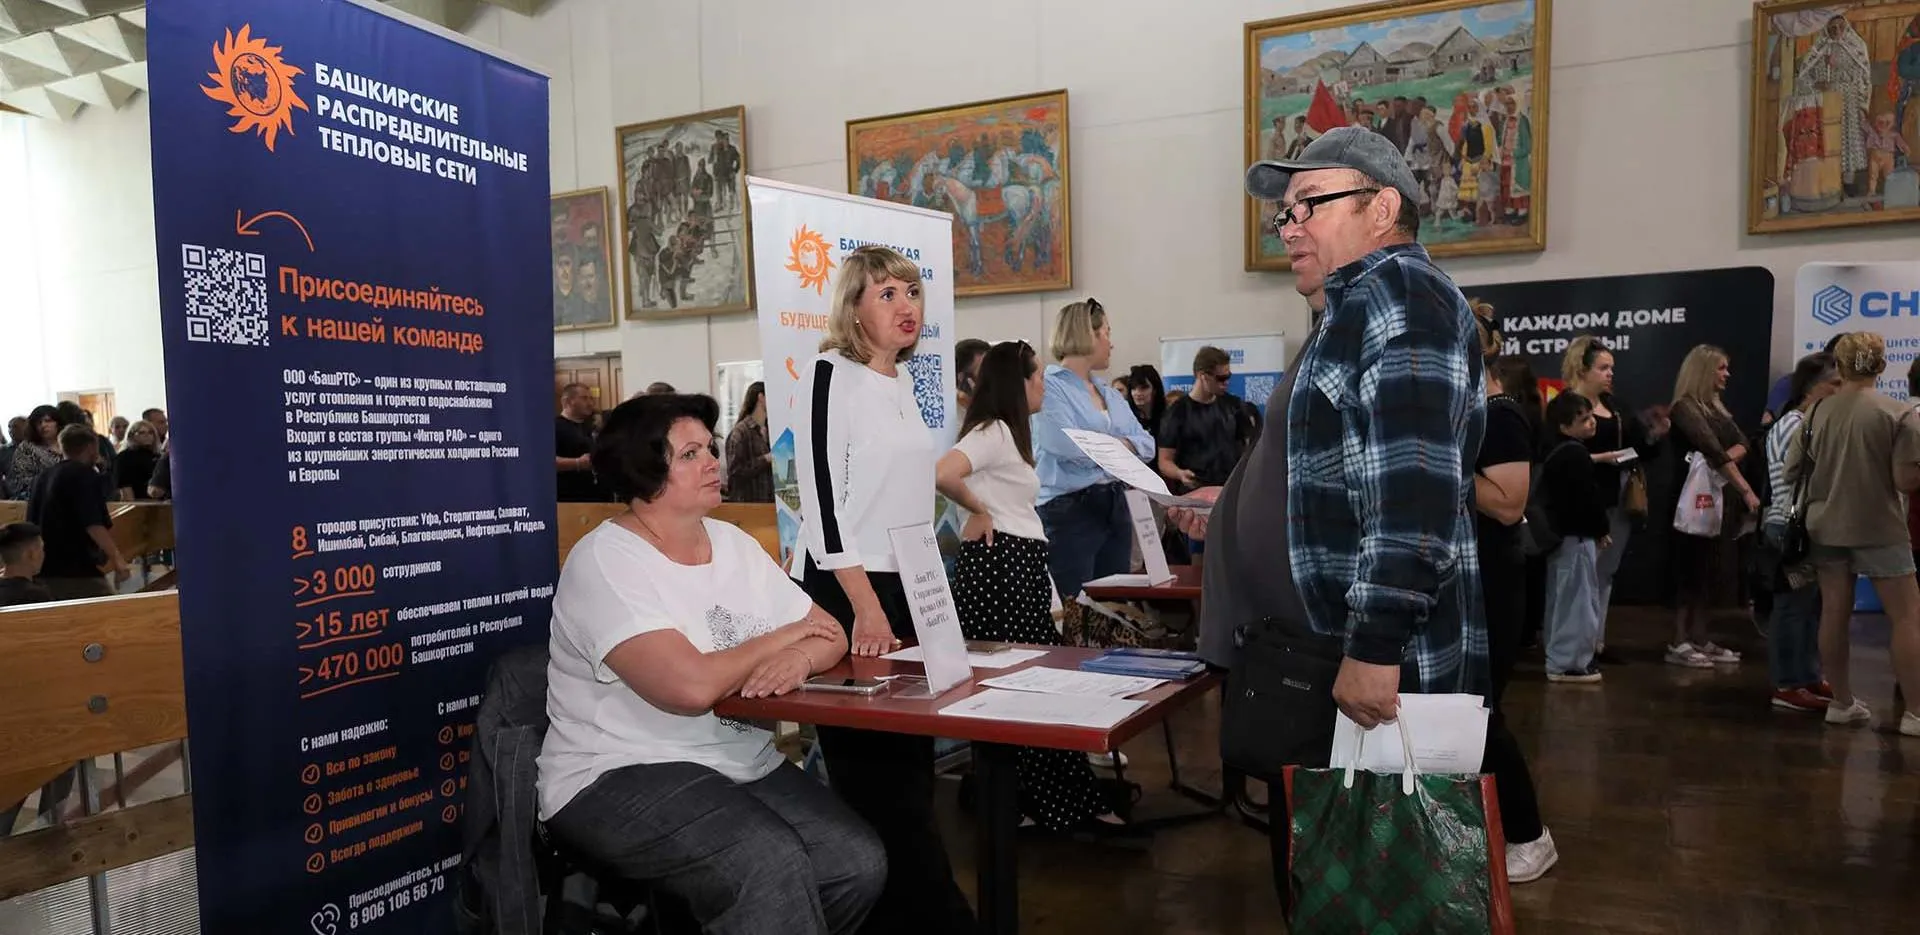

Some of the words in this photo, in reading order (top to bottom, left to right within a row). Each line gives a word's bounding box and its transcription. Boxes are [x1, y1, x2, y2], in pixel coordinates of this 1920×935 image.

[316, 62, 459, 125] БАШКИРСКИЕ
[317, 95, 528, 172] РАСПРЕДЕЛИТЕЛЬНЫЕ
[318, 127, 431, 173] ТЕПЛОВЫЕ
[436, 156, 477, 185] СЕТИ
[279, 266, 484, 316] Присоединяйтесь
[780, 311, 828, 330] БУДУЩЕ
[1503, 311, 1609, 332] КАЖДОМ
[1615, 307, 1686, 329] ДОМЕ
[282, 315, 298, 336] к
[307, 316, 385, 344] нашей
[393, 326, 483, 353] команде
[1526, 335, 1630, 355] СТРЫ!
[284, 369, 305, 384] ООО
[308, 371, 361, 387] «БашРТС»
[375, 376, 398, 390] один
[400, 378, 411, 389] из
[414, 378, 453, 391] крупных
[455, 380, 507, 393] поставщиков
[285, 391, 316, 406] услуг
[319, 392, 373, 405] отопления
[376, 394, 383, 406] и
[385, 395, 426, 408] горячего
[286, 411, 293, 423] в
[296, 409, 359, 426] Республике
[362, 411, 430, 426] Башкортостан
[286, 429, 326, 445] Входит
[329, 431, 335, 442] в
[338, 431, 373, 442] состав
[376, 431, 411, 445] группы
[413, 429, 444, 444] «Интер
[446, 429, 467, 442] РАО»
[288, 450, 301, 463] из
[305, 447, 369, 464] крупнейших
[371, 448, 445, 462] энергетических
[447, 448, 491, 460] холдингов
[491, 445, 519, 458] России
[289, 470, 297, 482] и
[299, 467, 340, 483] Европы
[317, 520, 357, 535] городов
[359, 515, 419, 532] присутствия:
[421, 512, 441, 527] Уфа,
[443, 509, 498, 524] Стерлитамак,
[292, 526, 307, 551] 8
[318, 534, 367, 552] Ишимбай,
[369, 531, 399, 547] Сибай,
[402, 528, 464, 544] Благовещенск,
[514, 520, 545, 533] Агидель
[335, 564, 375, 591] 000
[383, 561, 441, 579] сотрудников
[397, 601, 461, 622] обеспечиваем
[462, 595, 492, 610] теплом
[494, 595, 500, 604] и
[501, 586, 529, 604] горячей
[531, 584, 553, 599] водой
[350, 608, 390, 632] лет
[411, 623, 471, 647] потребителей
[473, 624, 478, 635] в
[365, 643, 403, 671] 000
[411, 642, 474, 664] Башкортостан
[438, 702, 444, 715] С
[446, 697, 468, 713] нами
[469, 695, 479, 706] не
[301, 737, 308, 752] С
[311, 731, 339, 749] нами
[341, 719, 388, 740] надежно:
[325, 761, 345, 776] Все
[348, 756, 360, 769] по
[363, 745, 396, 765] закону
[328, 784, 364, 805] Забота
[376, 767, 419, 789] здоровье
[330, 806, 388, 835] Привилегии
[398, 790, 433, 810] бонусы
[330, 842, 366, 864] Всегда
[349, 866, 432, 909] Присоединяйтесь
[434, 862, 440, 873] к
[350, 911, 358, 929] 8
[361, 901, 385, 924] 906
[388, 890, 410, 912] 106
[413, 882, 427, 901] 56
[430, 875, 444, 895] 70
